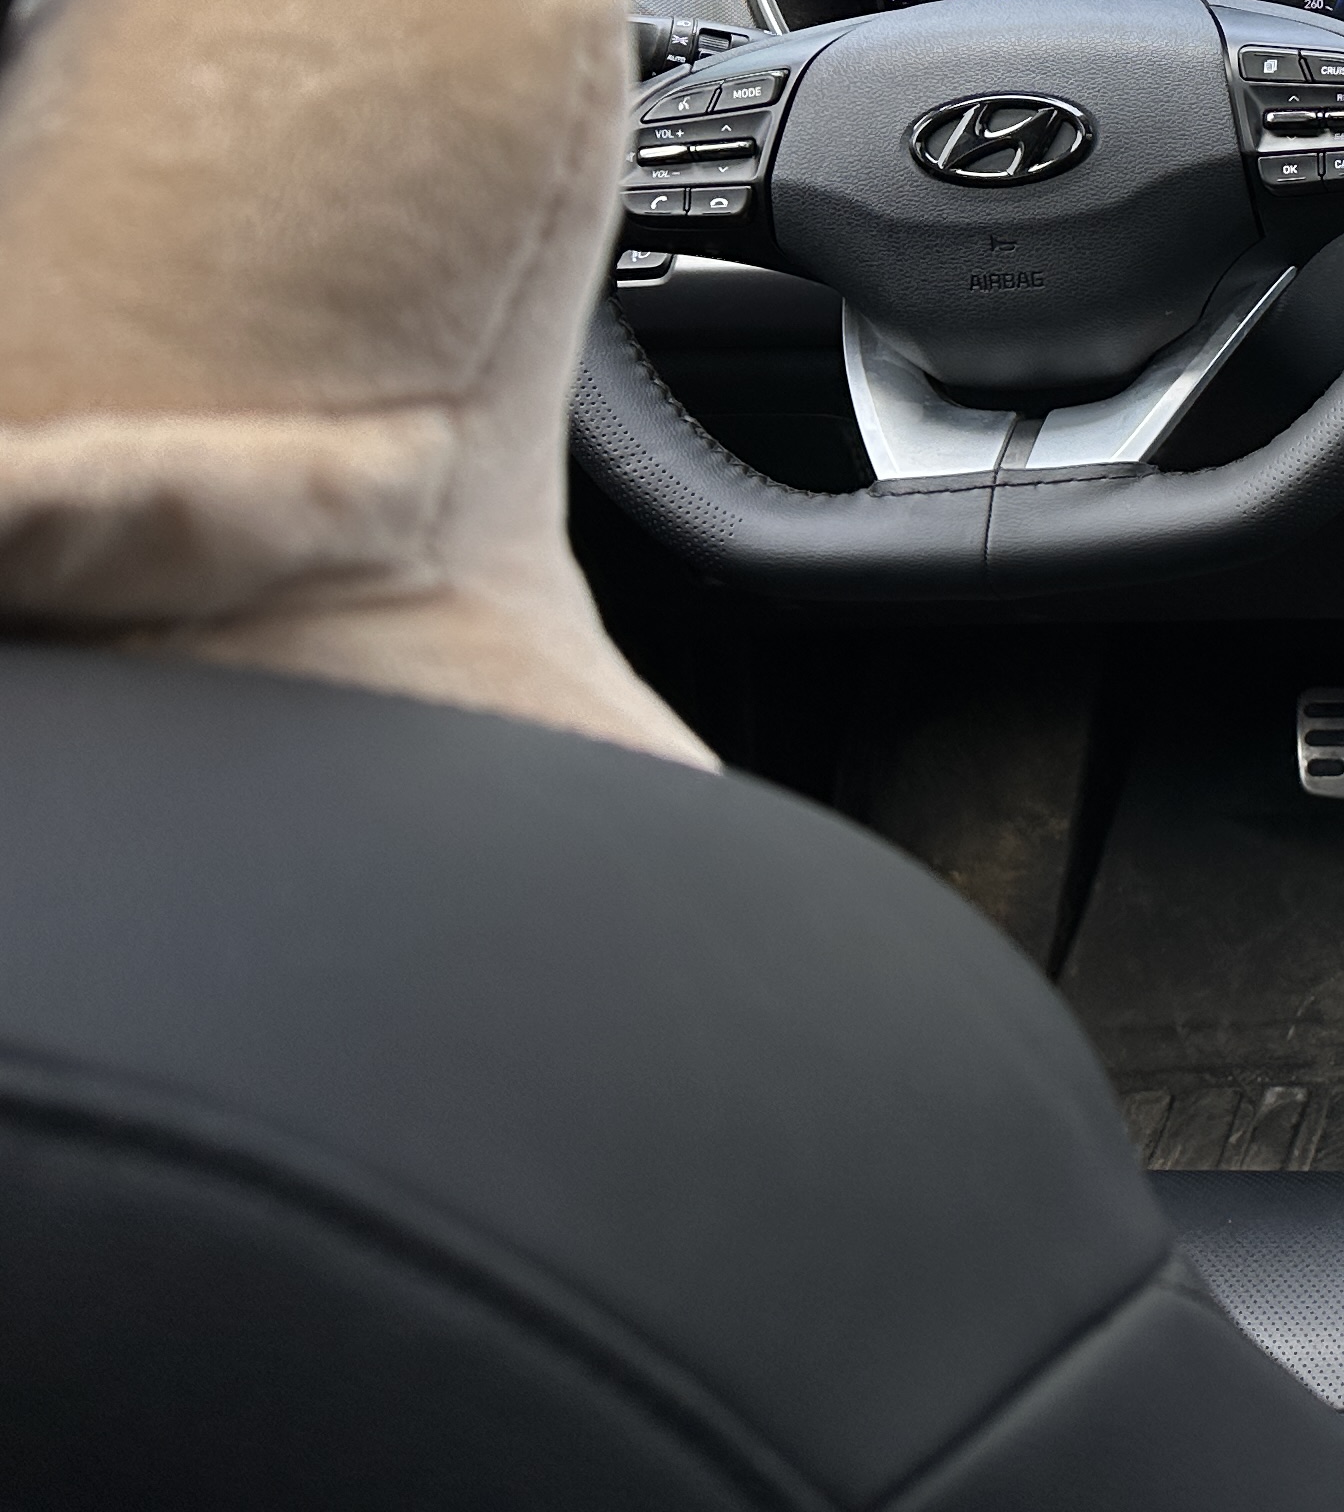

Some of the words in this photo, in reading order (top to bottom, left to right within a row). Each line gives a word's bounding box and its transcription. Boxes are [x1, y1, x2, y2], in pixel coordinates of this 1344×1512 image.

[733, 86, 762, 99] MODE
[1282, 164, 1298, 174] OK
[970, 271, 1045, 292] AIRBAG
